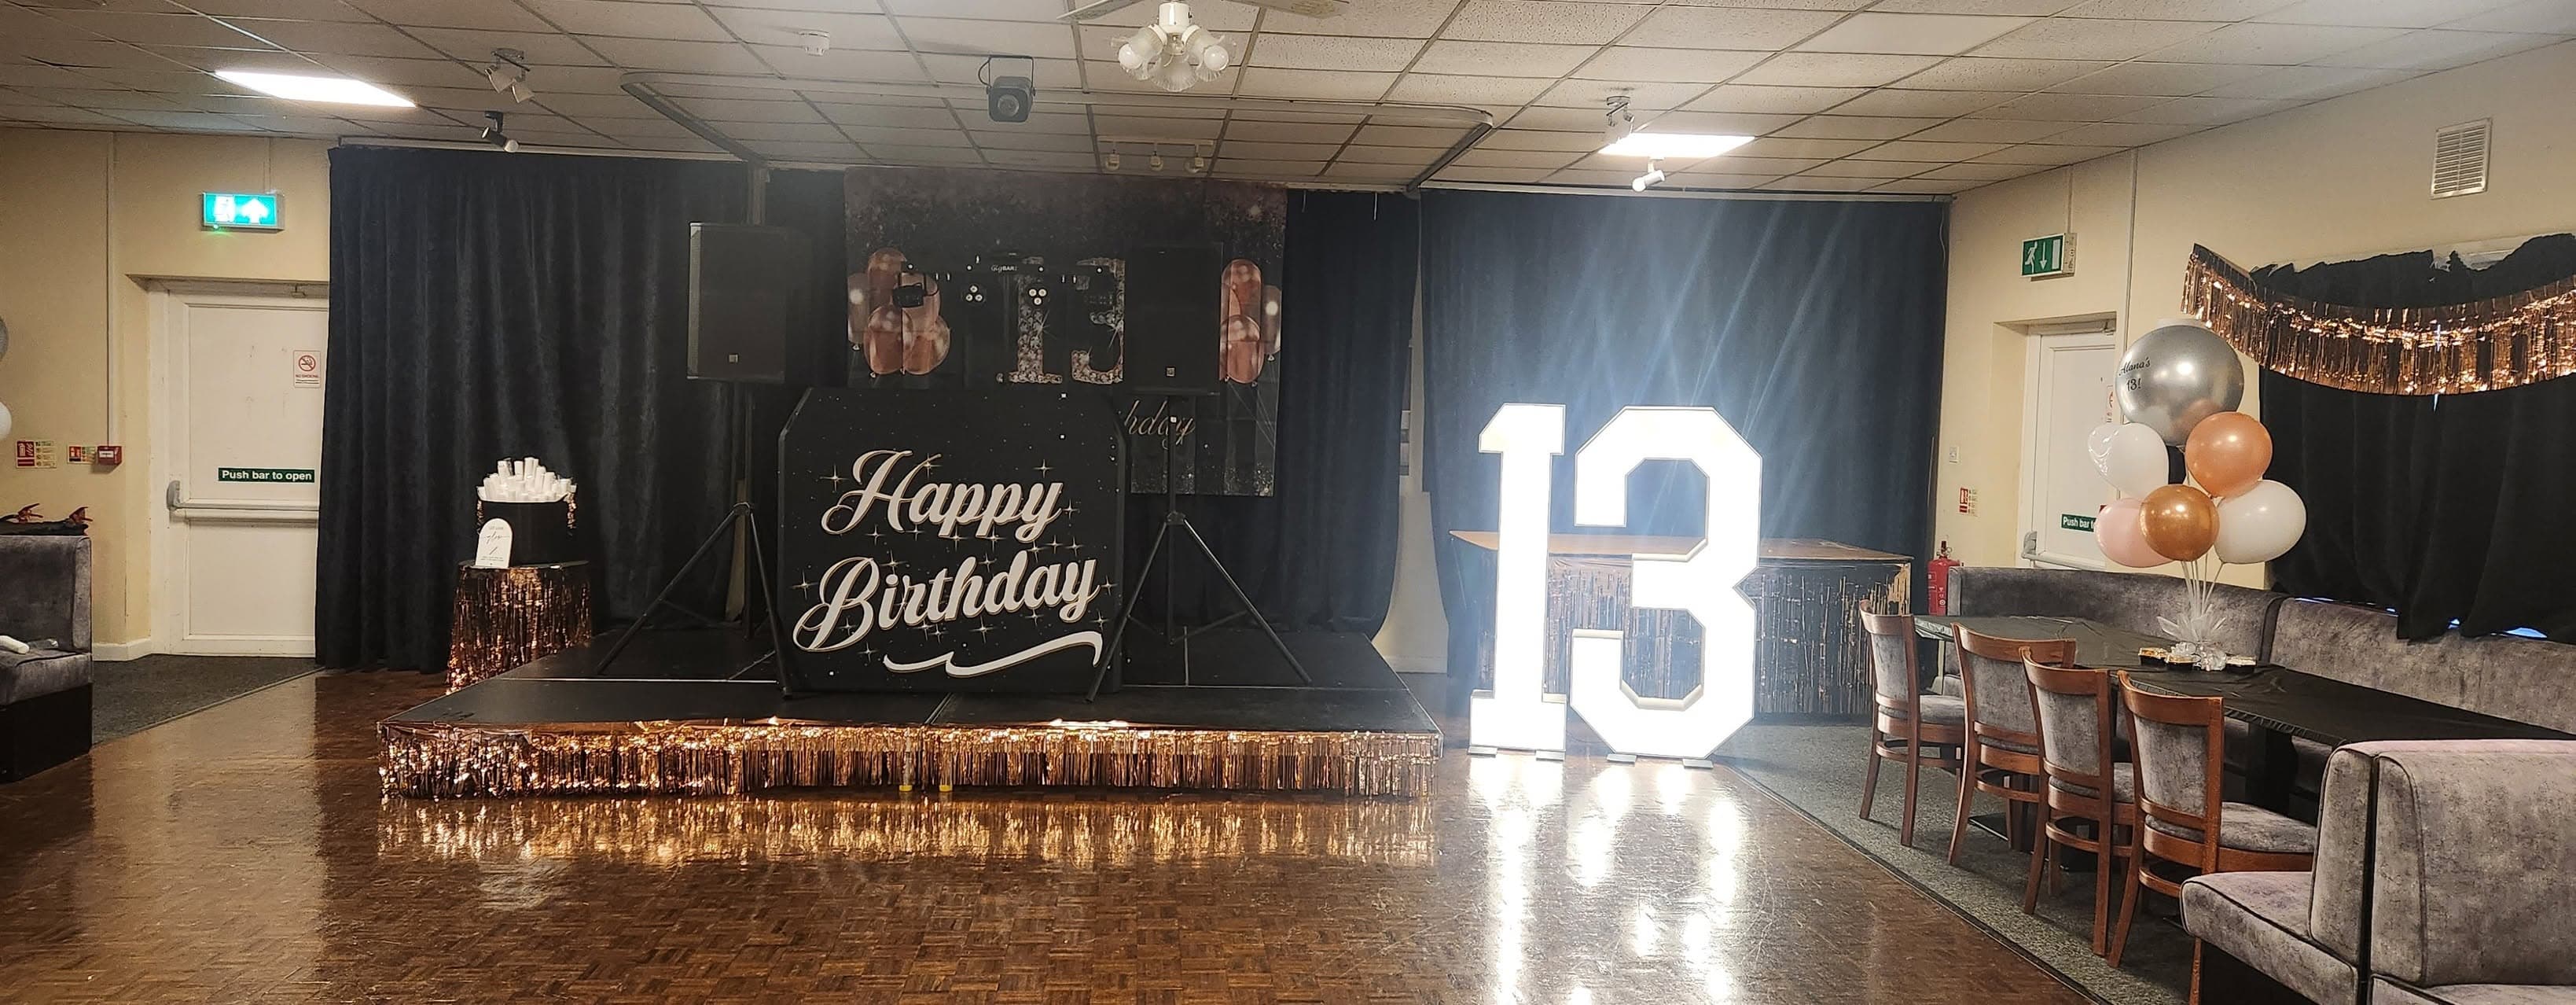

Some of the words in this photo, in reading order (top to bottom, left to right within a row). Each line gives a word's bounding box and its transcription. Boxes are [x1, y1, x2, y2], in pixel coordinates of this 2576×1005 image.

[2118, 356, 2151, 376] Alana's
[2126, 377, 2141, 392] 13!
[222, 469, 249, 479] Push
[252, 471, 270, 480] bar
[272, 471, 283, 480] to
[285, 473, 312, 482] open
[821, 450, 1064, 543] Happy
[2063, 516, 2078, 528] Push
[2079, 518, 2089, 528] bar
[1469, 403, 1762, 760] 13
[792, 550, 1101, 653] Birthday
